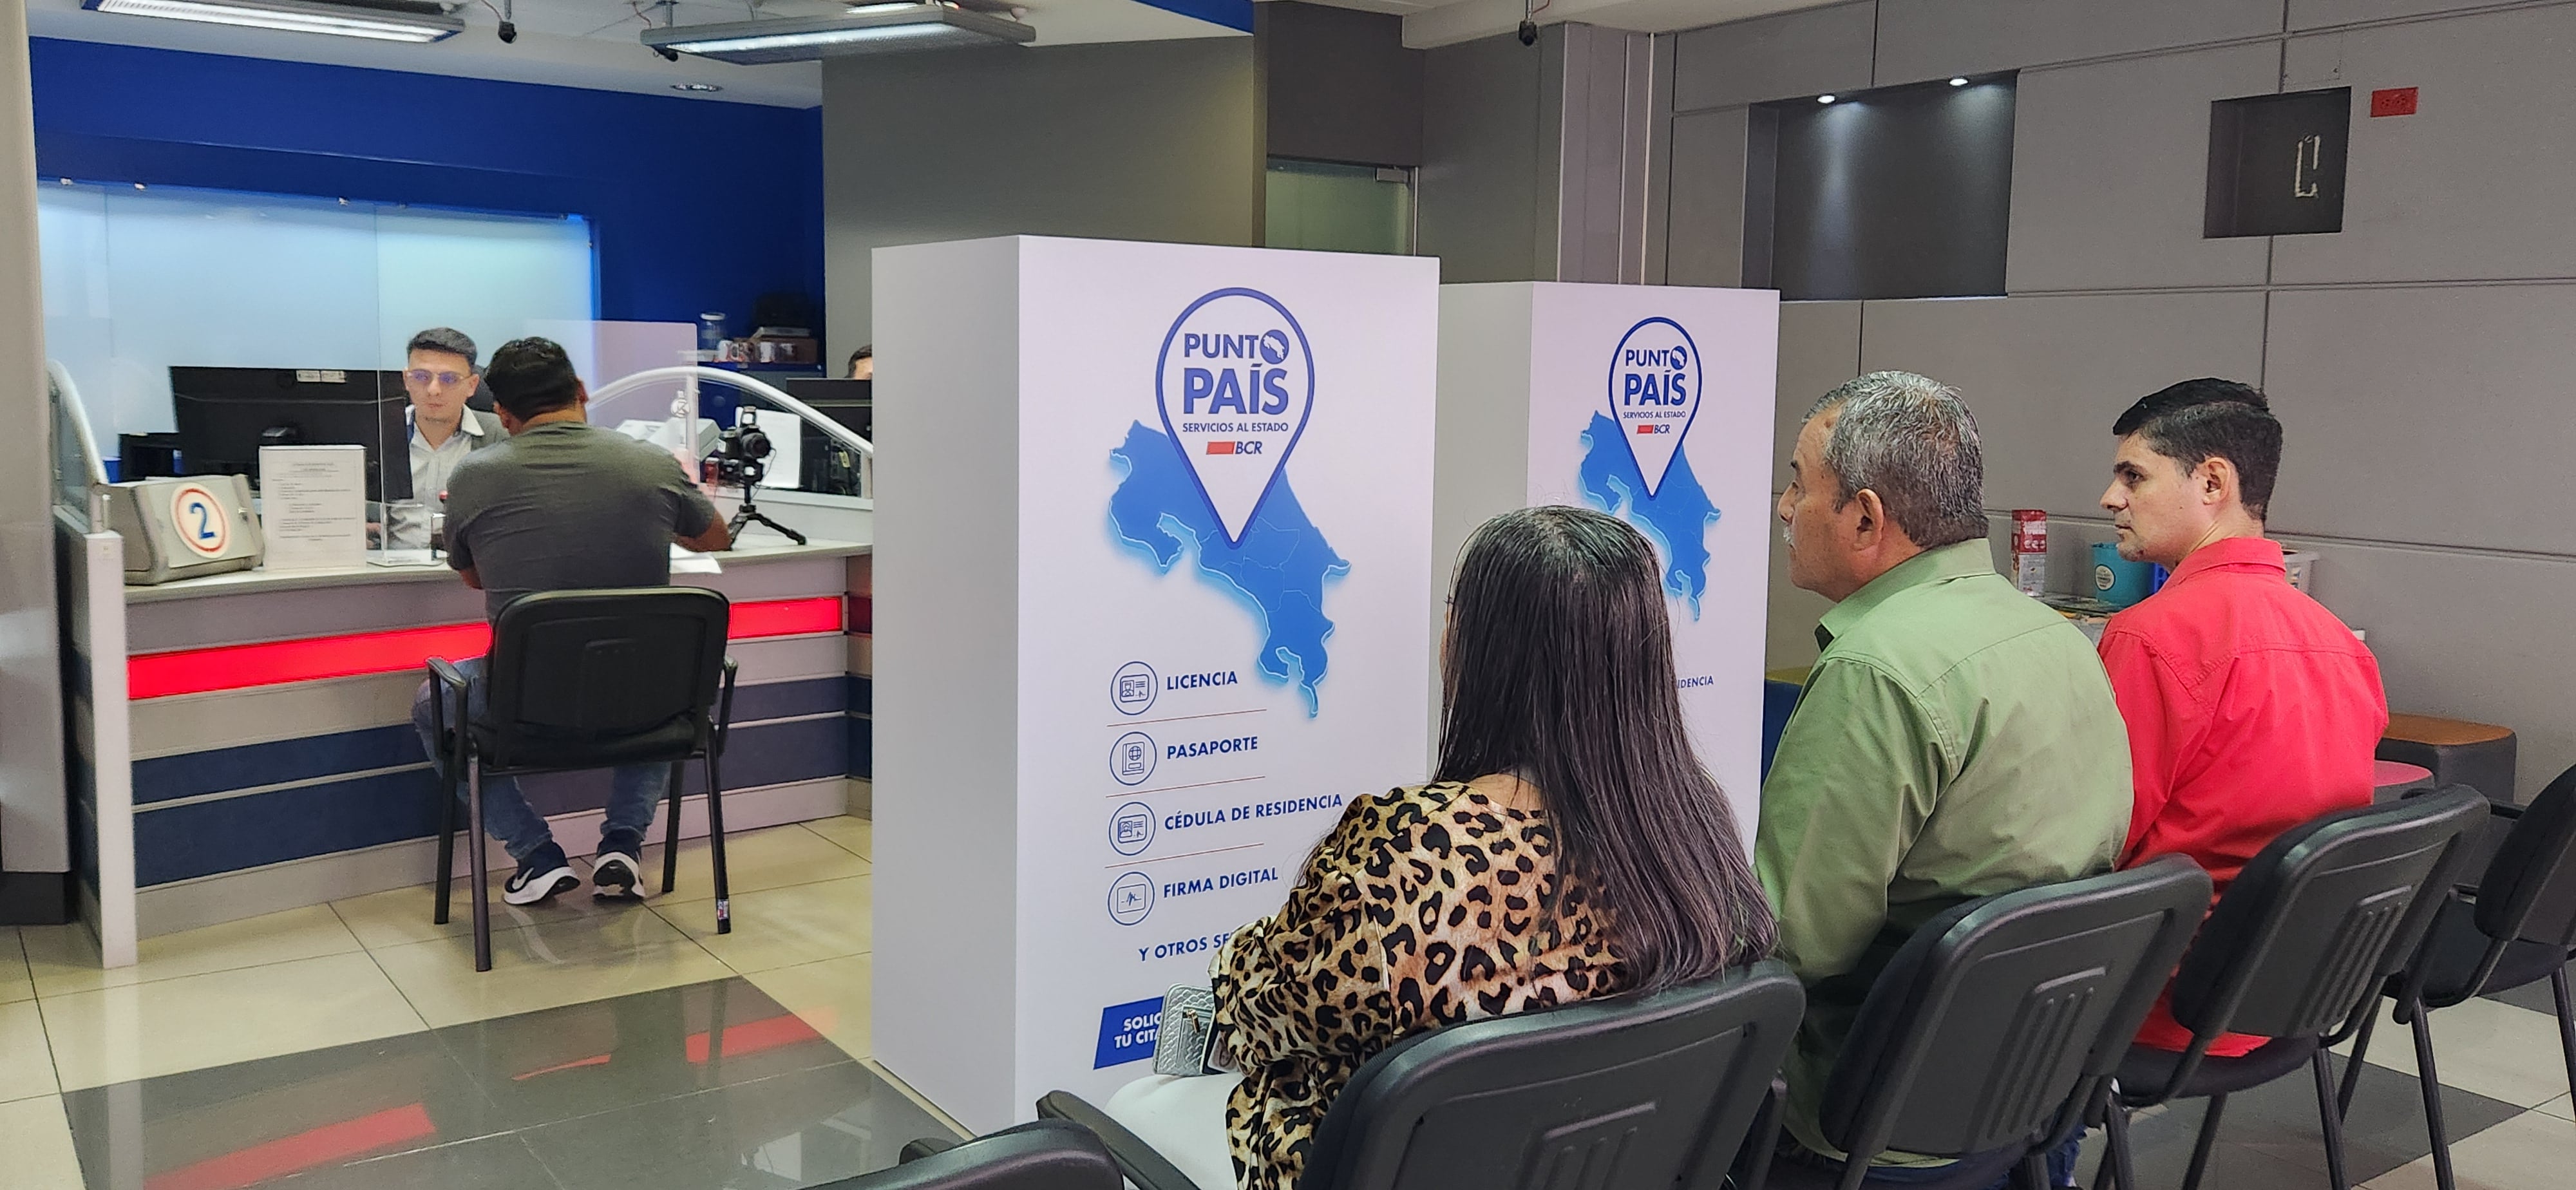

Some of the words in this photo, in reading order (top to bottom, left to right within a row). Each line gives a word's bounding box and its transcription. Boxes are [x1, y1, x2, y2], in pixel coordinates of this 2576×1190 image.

[1184, 363, 1288, 415] PAÍS
[1625, 369, 1686, 406] PAÍS
[1183, 423, 1233, 432] SERVICIOS
[1236, 423, 1248, 431] AL
[1252, 422, 1288, 431] ESTADO
[1654, 424, 1670, 433] BCR
[1236, 441, 1262, 454] BCR
[190, 502, 215, 539] 2
[1168, 672, 1237, 690] LICENCIA
[1168, 737, 1257, 759] PASAPORTE
[1165, 810, 1226, 829] CÉDULA
[1232, 806, 1249, 820] DE
[1256, 793, 1343, 817] RESIDENCIA
[1164, 878, 1213, 898] FIRMA
[1220, 868, 1278, 889] DIGITAL
[1139, 948, 1148, 961] Y
[1155, 938, 1207, 958] OTROS
[1115, 1034, 1132, 1048] TU
